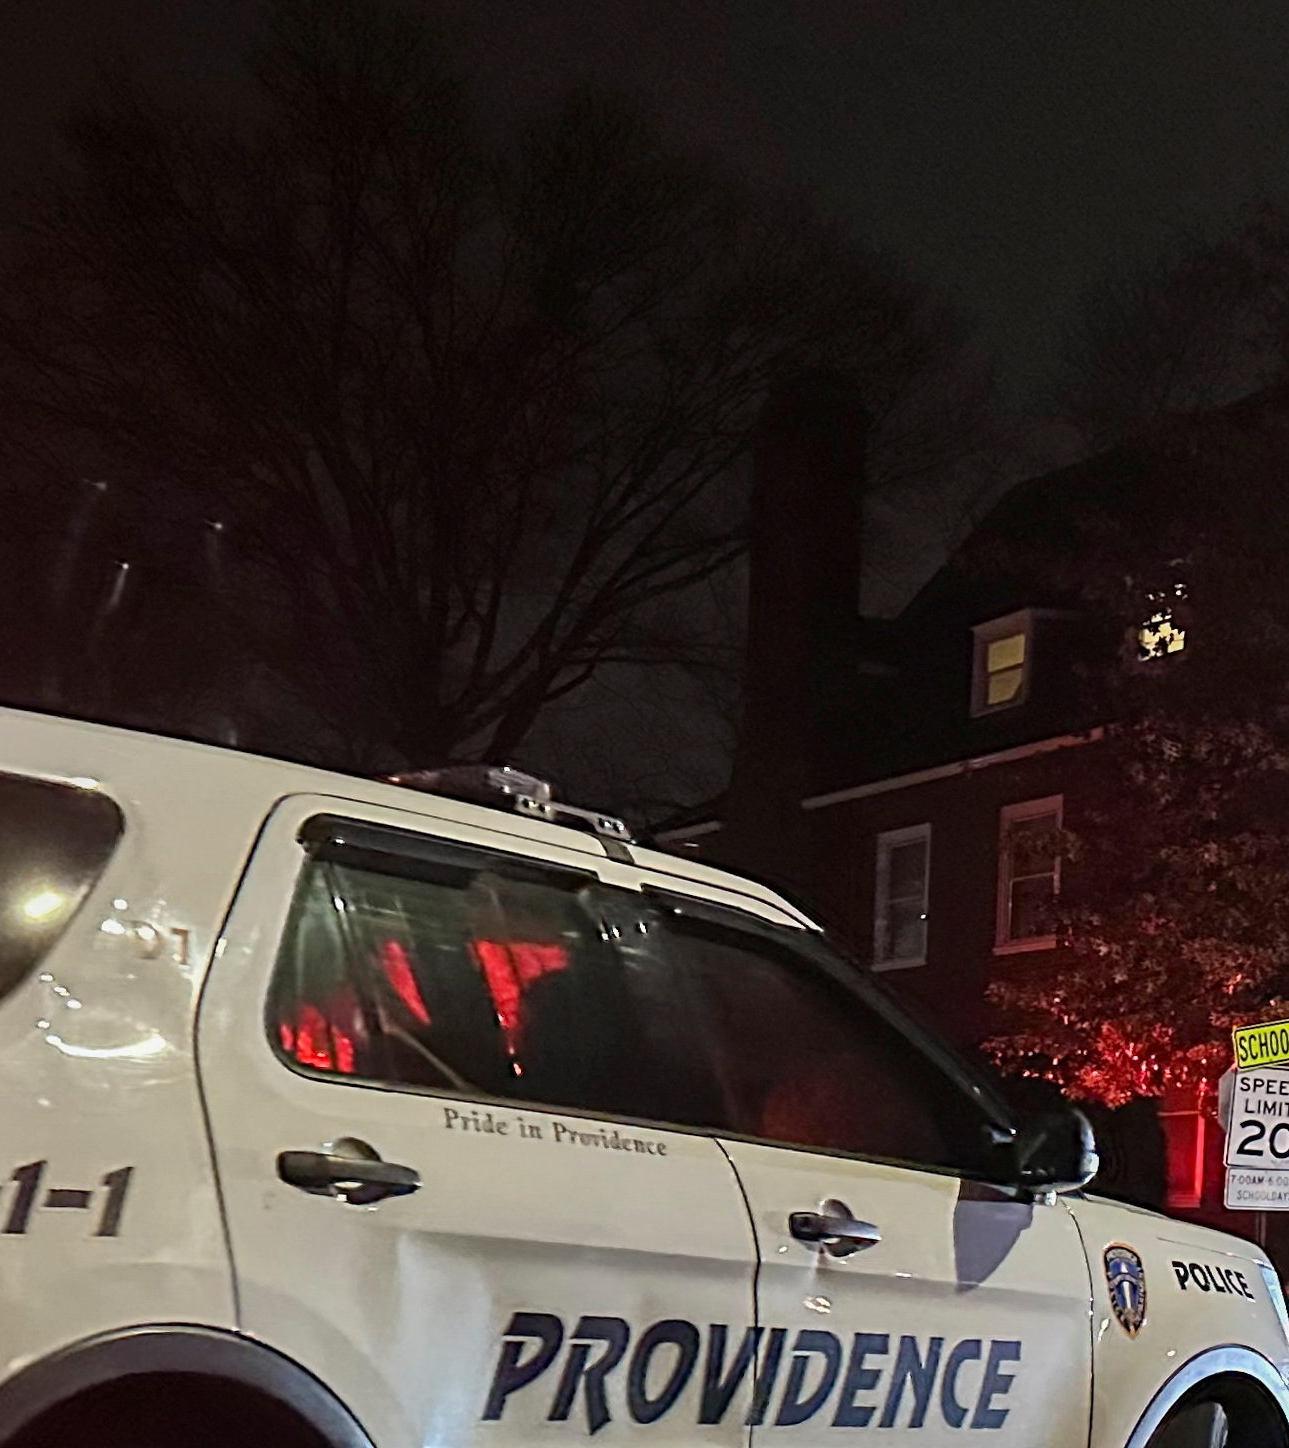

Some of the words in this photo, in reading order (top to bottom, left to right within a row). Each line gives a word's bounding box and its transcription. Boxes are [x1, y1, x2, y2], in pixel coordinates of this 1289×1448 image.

[443, 1107, 509, 1136] Pride
[518, 1117, 543, 1140] in
[552, 1121, 668, 1156] Providence
[1171, 1260, 1255, 1300] POLICE
[480, 1311, 1023, 1436] PROVIDENCE
